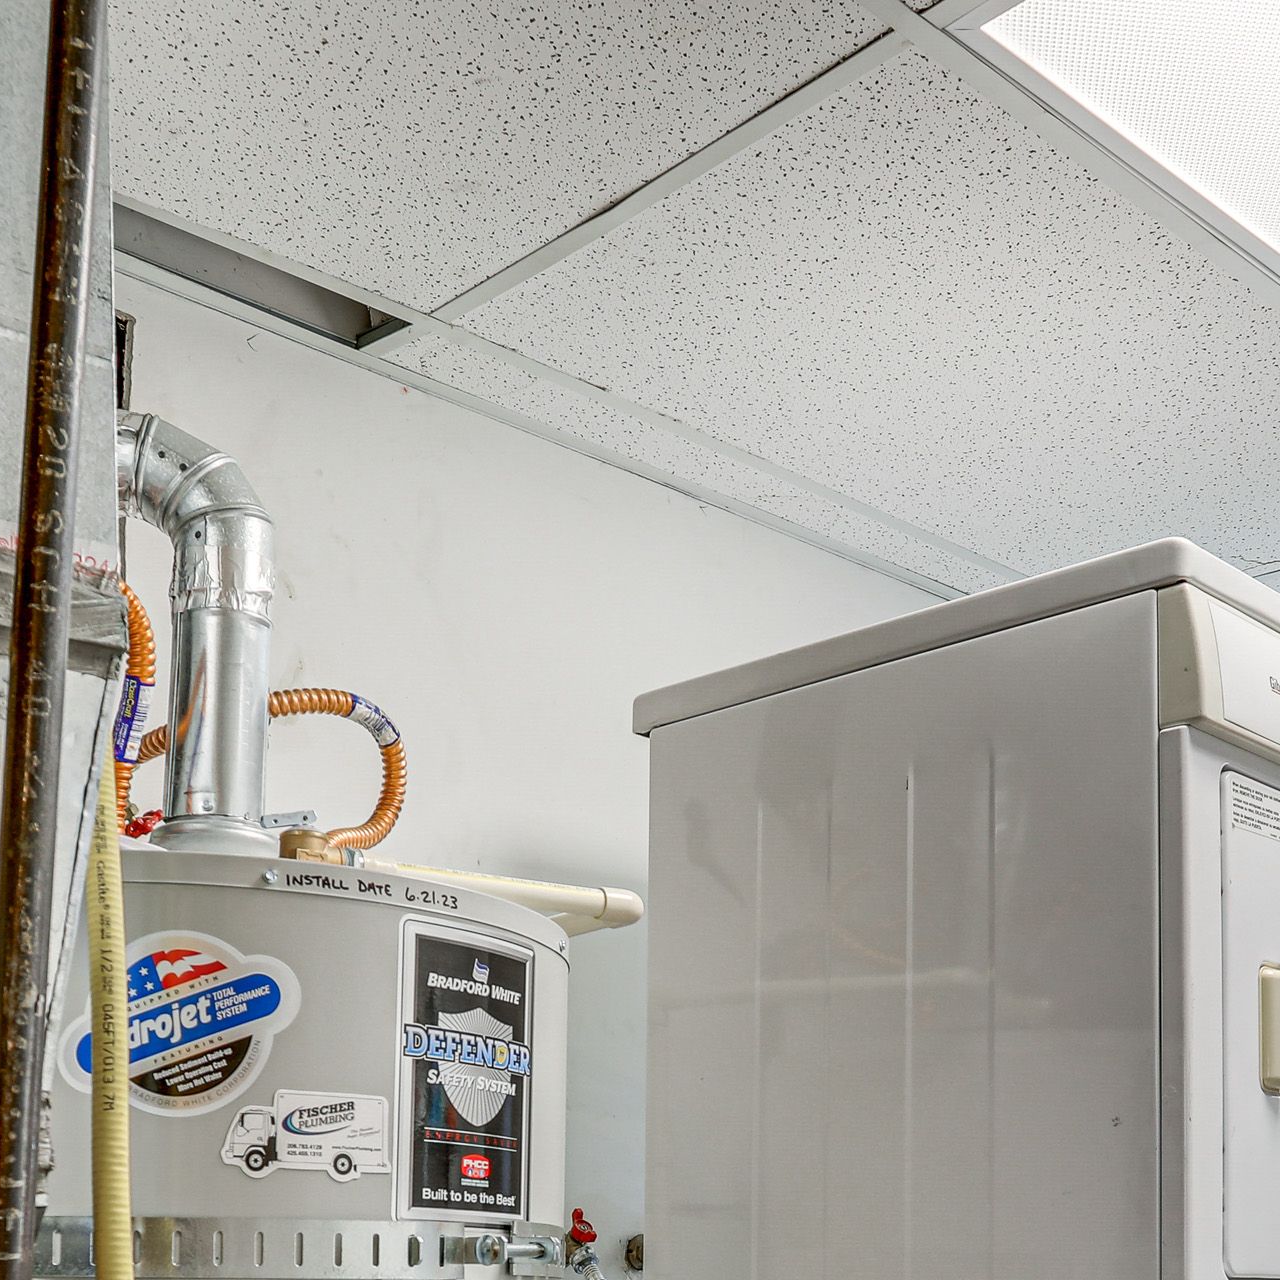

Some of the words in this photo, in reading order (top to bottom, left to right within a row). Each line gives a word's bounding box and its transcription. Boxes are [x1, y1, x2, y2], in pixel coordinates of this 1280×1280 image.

[286, 872, 349, 892] INSTALL
[357, 880, 393, 898] DATE
[404, 886, 459, 910] 6.21.23
[127, 987, 180, 1013] QUIPPED
[189, 975, 219, 990] WITH
[212, 986, 237, 1000] TOTAL
[214, 984, 271, 1011] PERFORMANCE
[427, 972, 490, 998] BRADFORD
[491, 983, 521, 1005] WHITE
[129, 995, 212, 1049] drojet
[216, 1003, 248, 1021] SYSTEM
[153, 1036, 224, 1064] FEATURING
[403, 1022, 532, 1077] DEFENDER
[179, 1056, 208, 1072] Sediment
[182, 1096, 213, 1107] WHITE
[216, 1039, 262, 1097] CORPORATION
[213, 1058, 228, 1071] Cost
[204, 1072, 223, 1085] Water
[426, 1068, 475, 1087] SAFETY
[477, 1075, 516, 1097] SYSTEM
[298, 1101, 355, 1119] FISCHER
[298, 1113, 355, 1129] PLUMBING
[462, 1158, 489, 1170] PHCC
[422, 1187, 448, 1201] Built
[449, 1190, 462, 1203] to
[464, 1190, 477, 1204] be
[479, 1192, 494, 1205] the
[496, 1193, 516, 1207] Best
